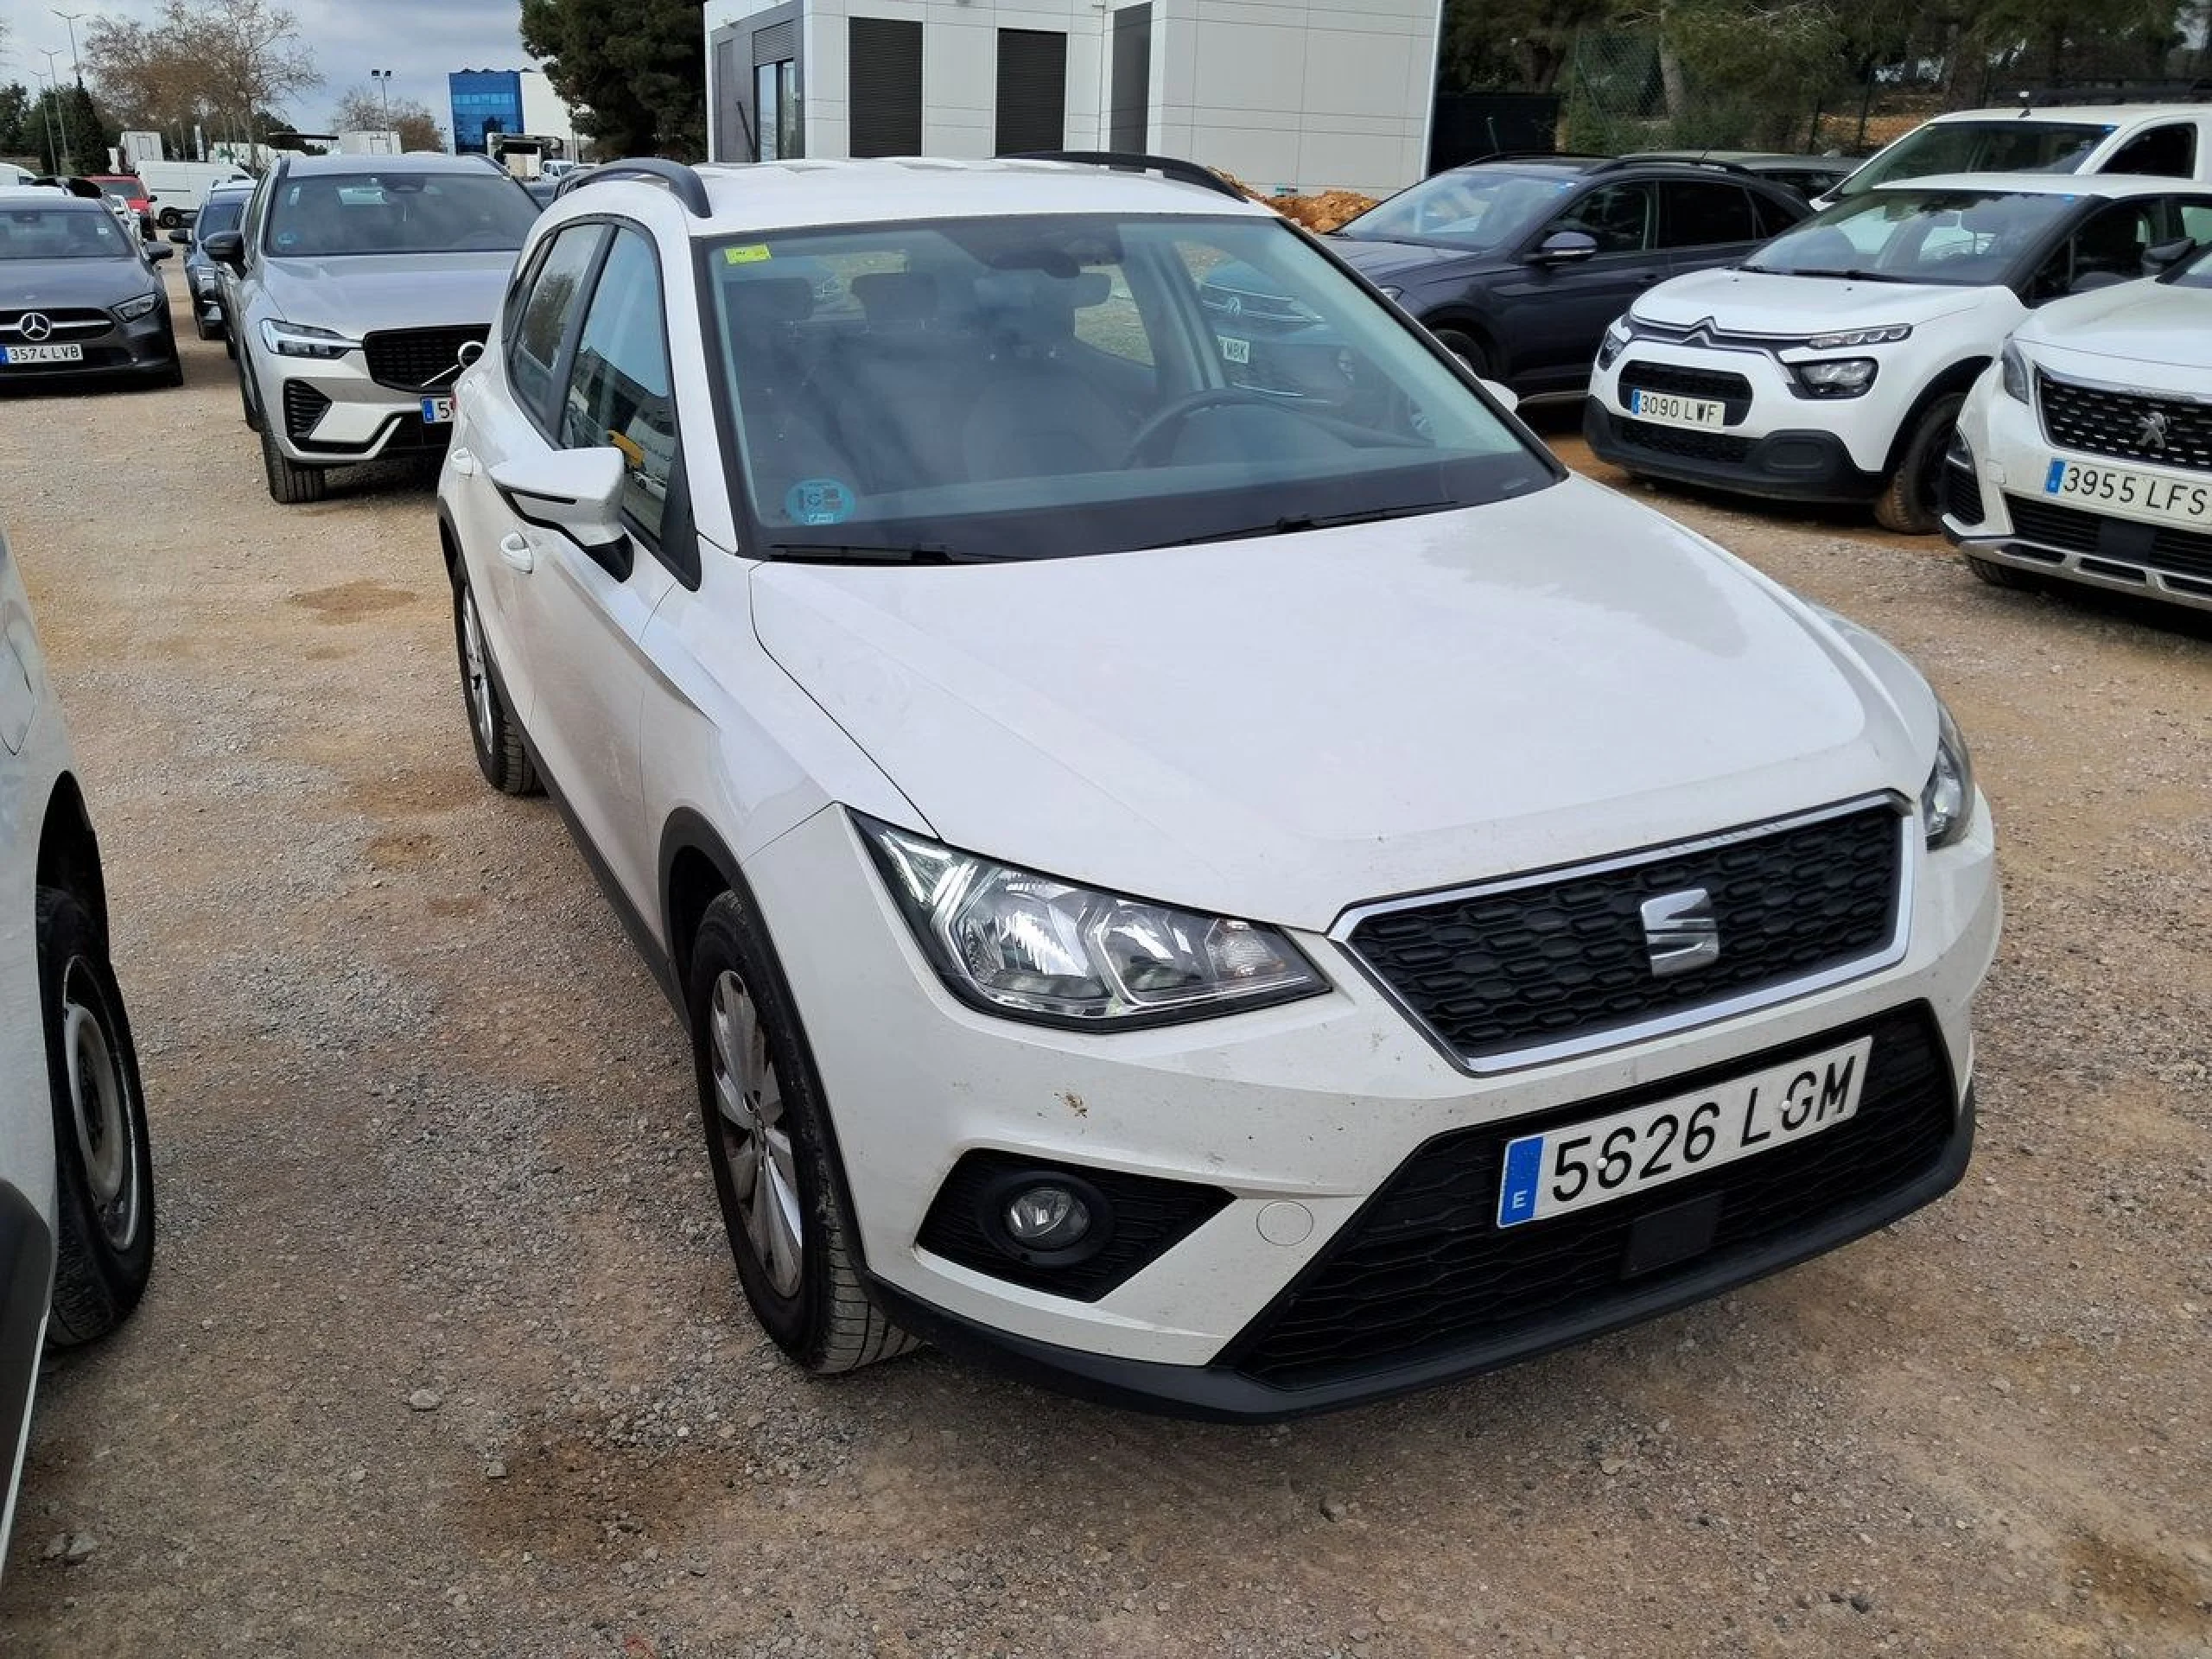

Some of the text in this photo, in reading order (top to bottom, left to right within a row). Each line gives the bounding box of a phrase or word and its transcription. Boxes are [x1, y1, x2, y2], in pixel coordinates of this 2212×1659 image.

[10, 346, 79, 360] 3574 LVB
[1641, 394, 1718, 423] 3090 LWF
[2063, 466, 2209, 516] 3955 LFS
[1511, 1054, 1856, 1210] E 5626 LGM
